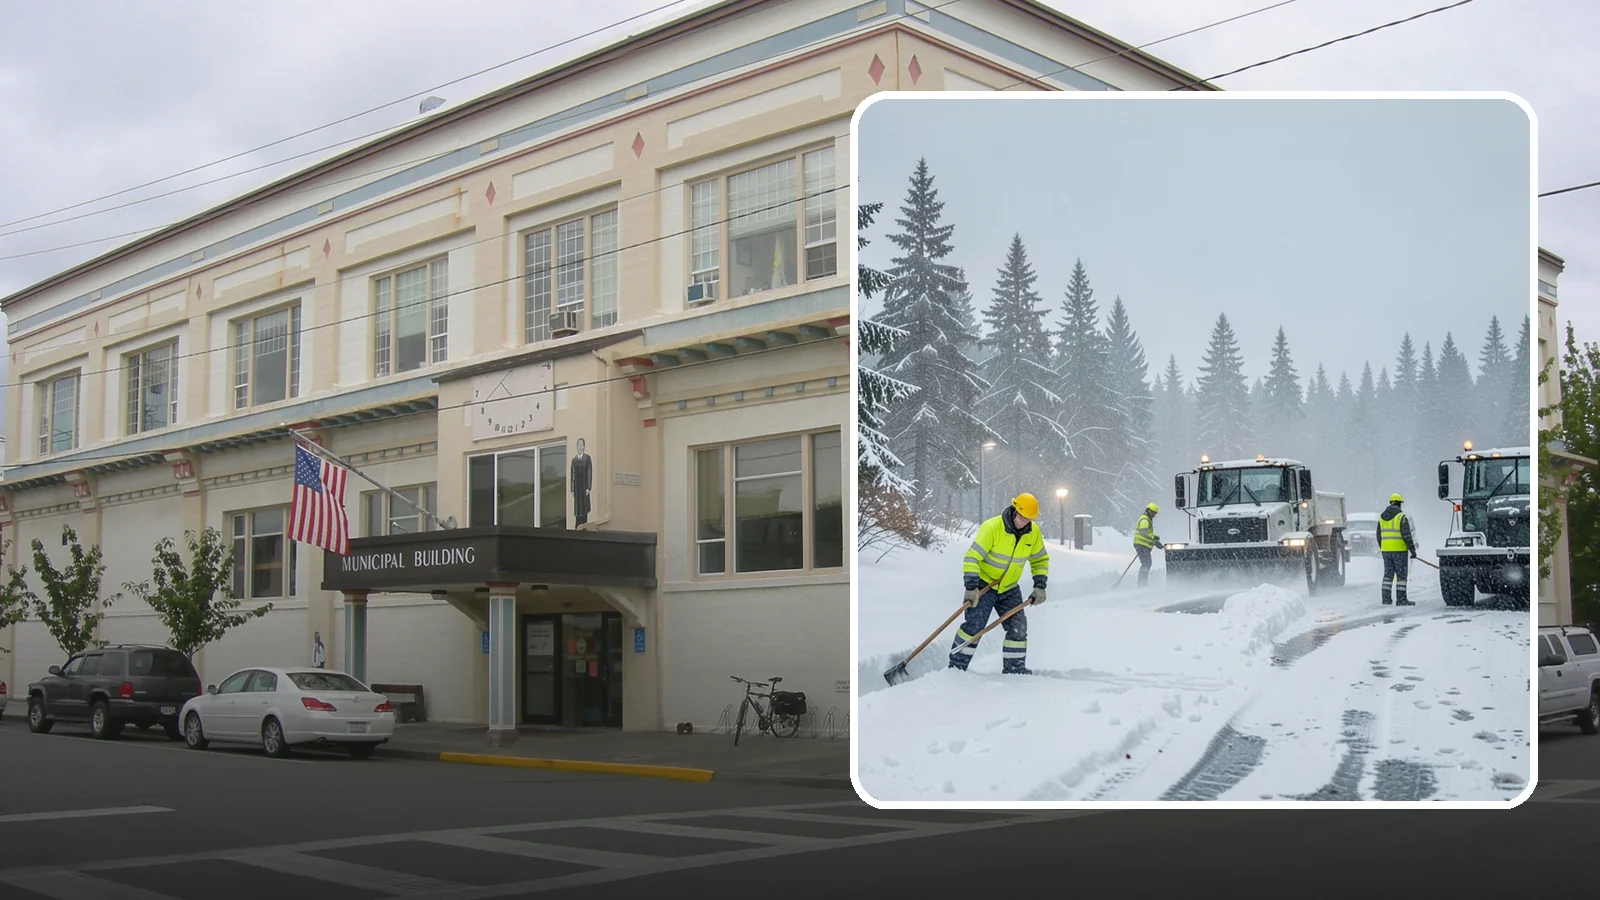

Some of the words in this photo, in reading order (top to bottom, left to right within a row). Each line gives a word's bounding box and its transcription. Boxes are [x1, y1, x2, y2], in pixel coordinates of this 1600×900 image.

[487, 417, 492, 426] 9
[529, 414, 533, 422] 3
[495, 423, 500, 431] 10
[521, 420, 526, 428] 2
[507, 425, 513, 433] 12
[342, 552, 405, 572] MUNICIPAL
[414, 546, 475, 567] BUILDING
